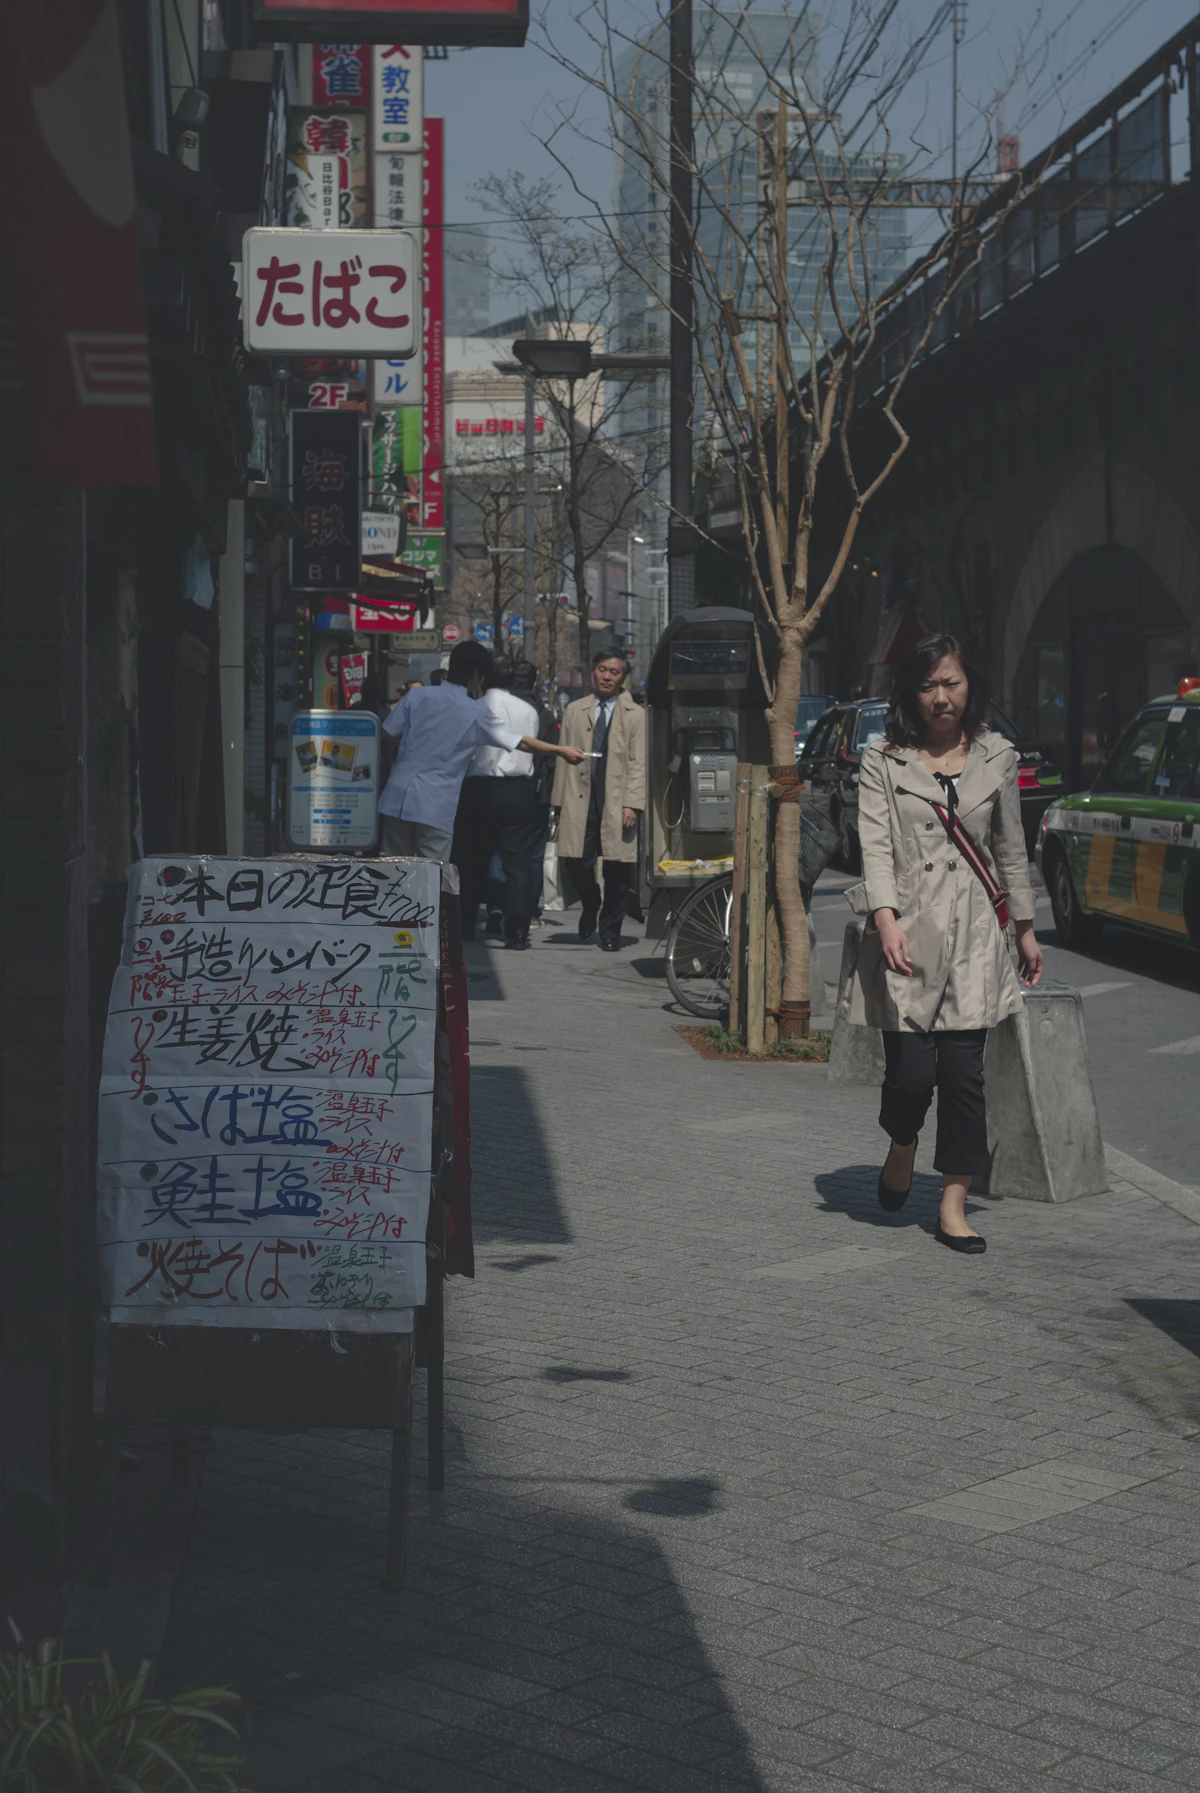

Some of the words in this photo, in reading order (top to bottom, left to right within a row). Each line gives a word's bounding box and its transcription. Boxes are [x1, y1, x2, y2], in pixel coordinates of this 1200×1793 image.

[320, 44, 362, 95] 雀
[388, 155, 405, 230] 旬報法律
[256, 255, 410, 329] たばこ
[309, 384, 347, 407] 2F
[302, 447, 351, 549] 海賊
[403, 550, 437, 562] コジマ
[170, 865, 389, 921] 本日の定食
[154, 1005, 315, 1072] 生姜焼
[306, 1008, 381, 1031] 温泉玉子
[310, 1027, 346, 1045] ライス
[151, 1085, 333, 1147] さば塩
[315, 1090, 393, 1122] 温泉玉子
[141, 1155, 322, 1228] 鮭塩
[313, 1161, 400, 1193] 温泉玉子
[125, 1234, 316, 1302] 焼そば
